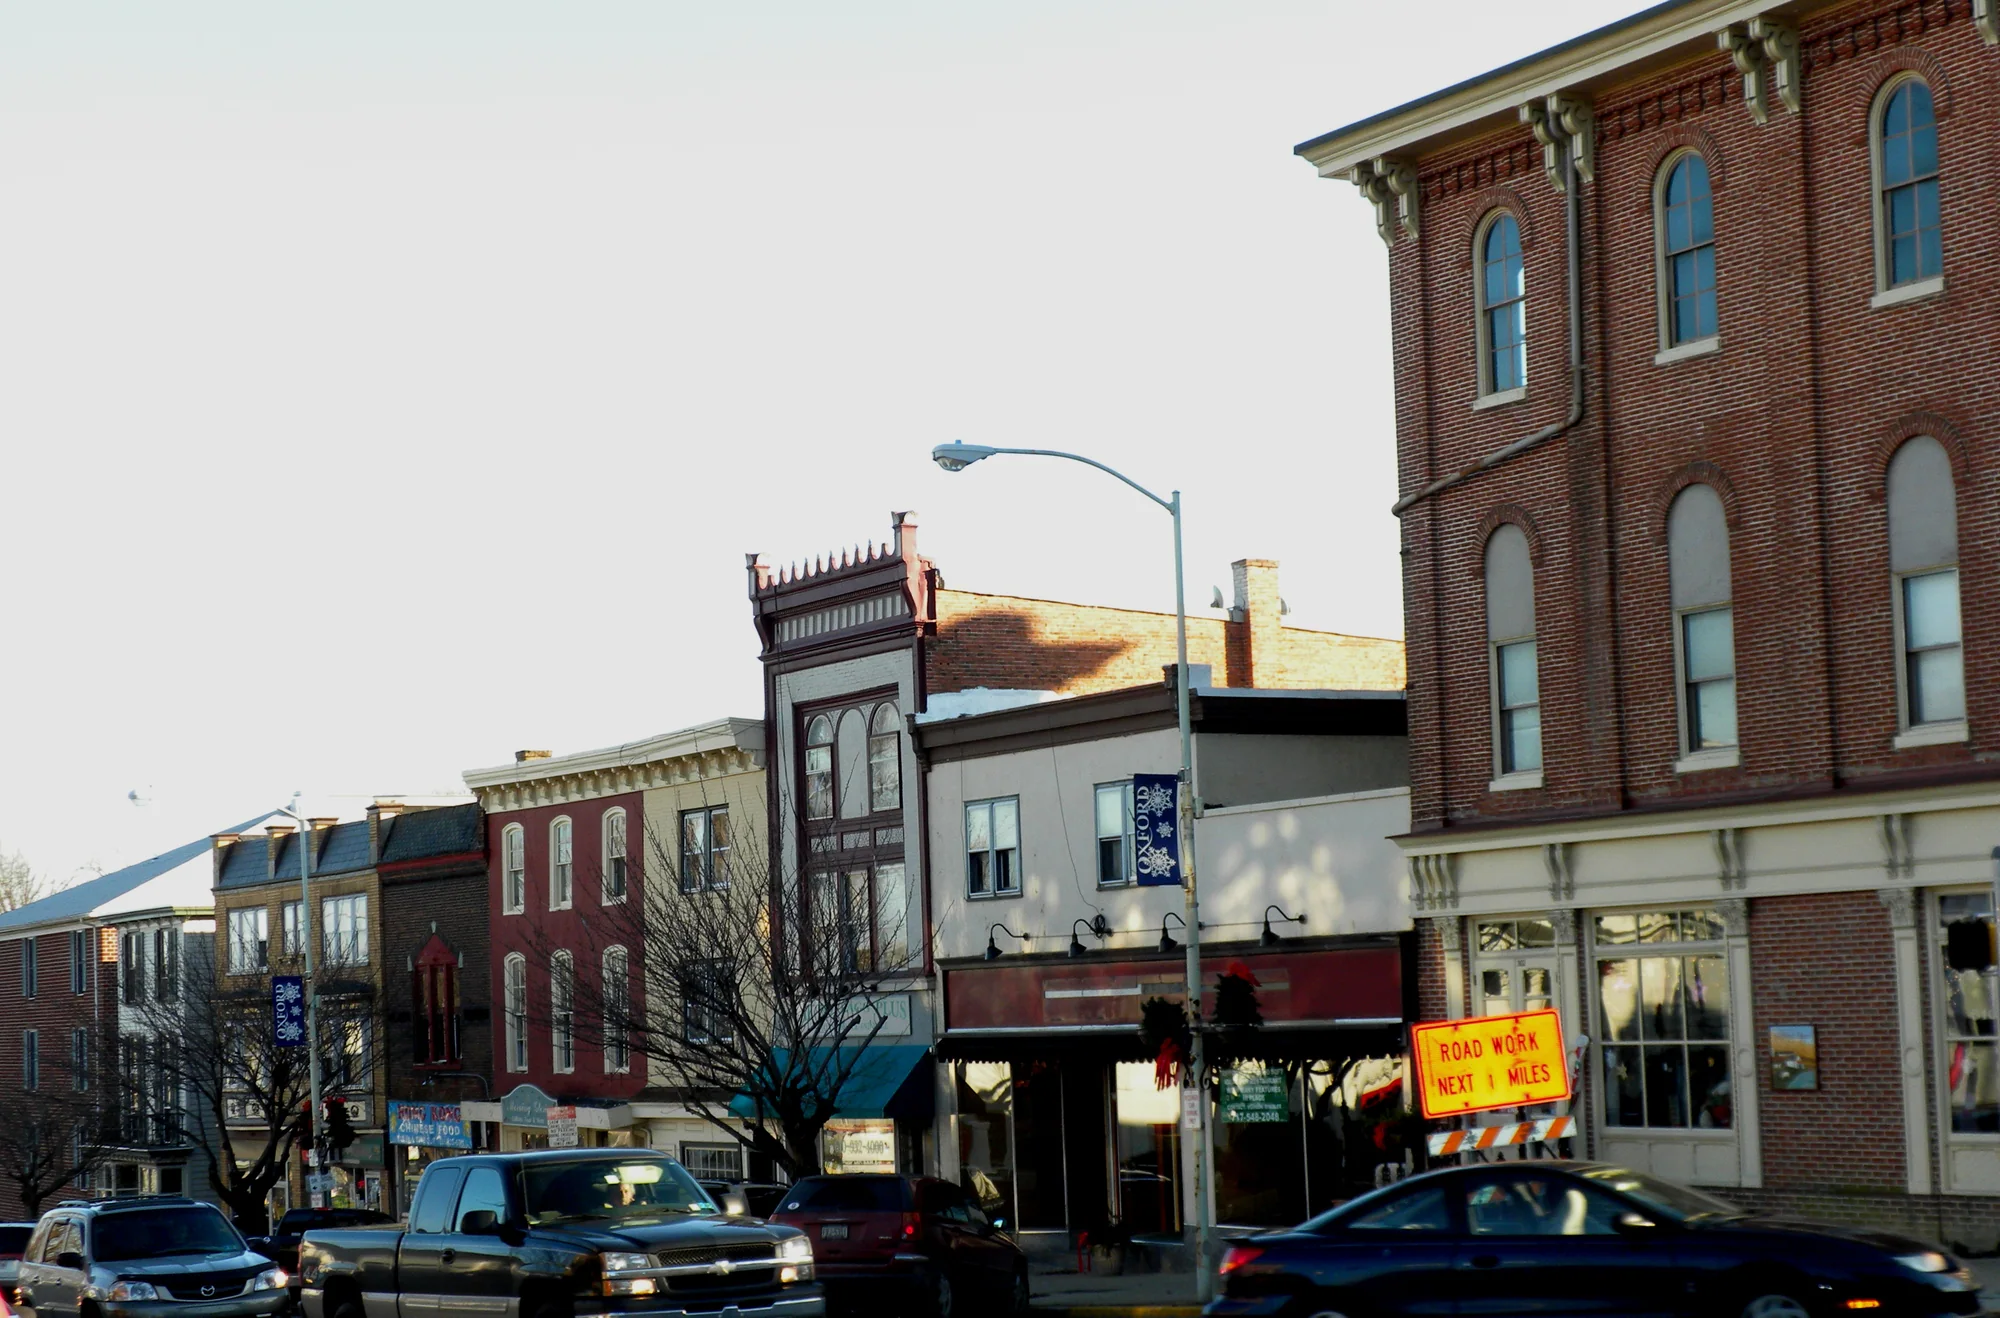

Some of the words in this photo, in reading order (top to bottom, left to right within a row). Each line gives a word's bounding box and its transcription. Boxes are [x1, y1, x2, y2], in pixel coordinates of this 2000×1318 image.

[1136, 785, 1153, 874] OXFORD
[275, 984, 288, 1040] OXFORD
[876, 1000, 907, 1019] PLUS
[1440, 1039, 1482, 1062] ROAD
[1491, 1031, 1539, 1056] WORK
[1255, 1086, 1281, 1094] FEATURES
[1437, 1073, 1473, 1096] NEXT
[1488, 1074, 1495, 1090] 1
[1508, 1064, 1550, 1087] MILES
[430, 1105, 461, 1123] KONG
[399, 1121, 435, 1134] CHINESE
[437, 1124, 460, 1136] FOOD
